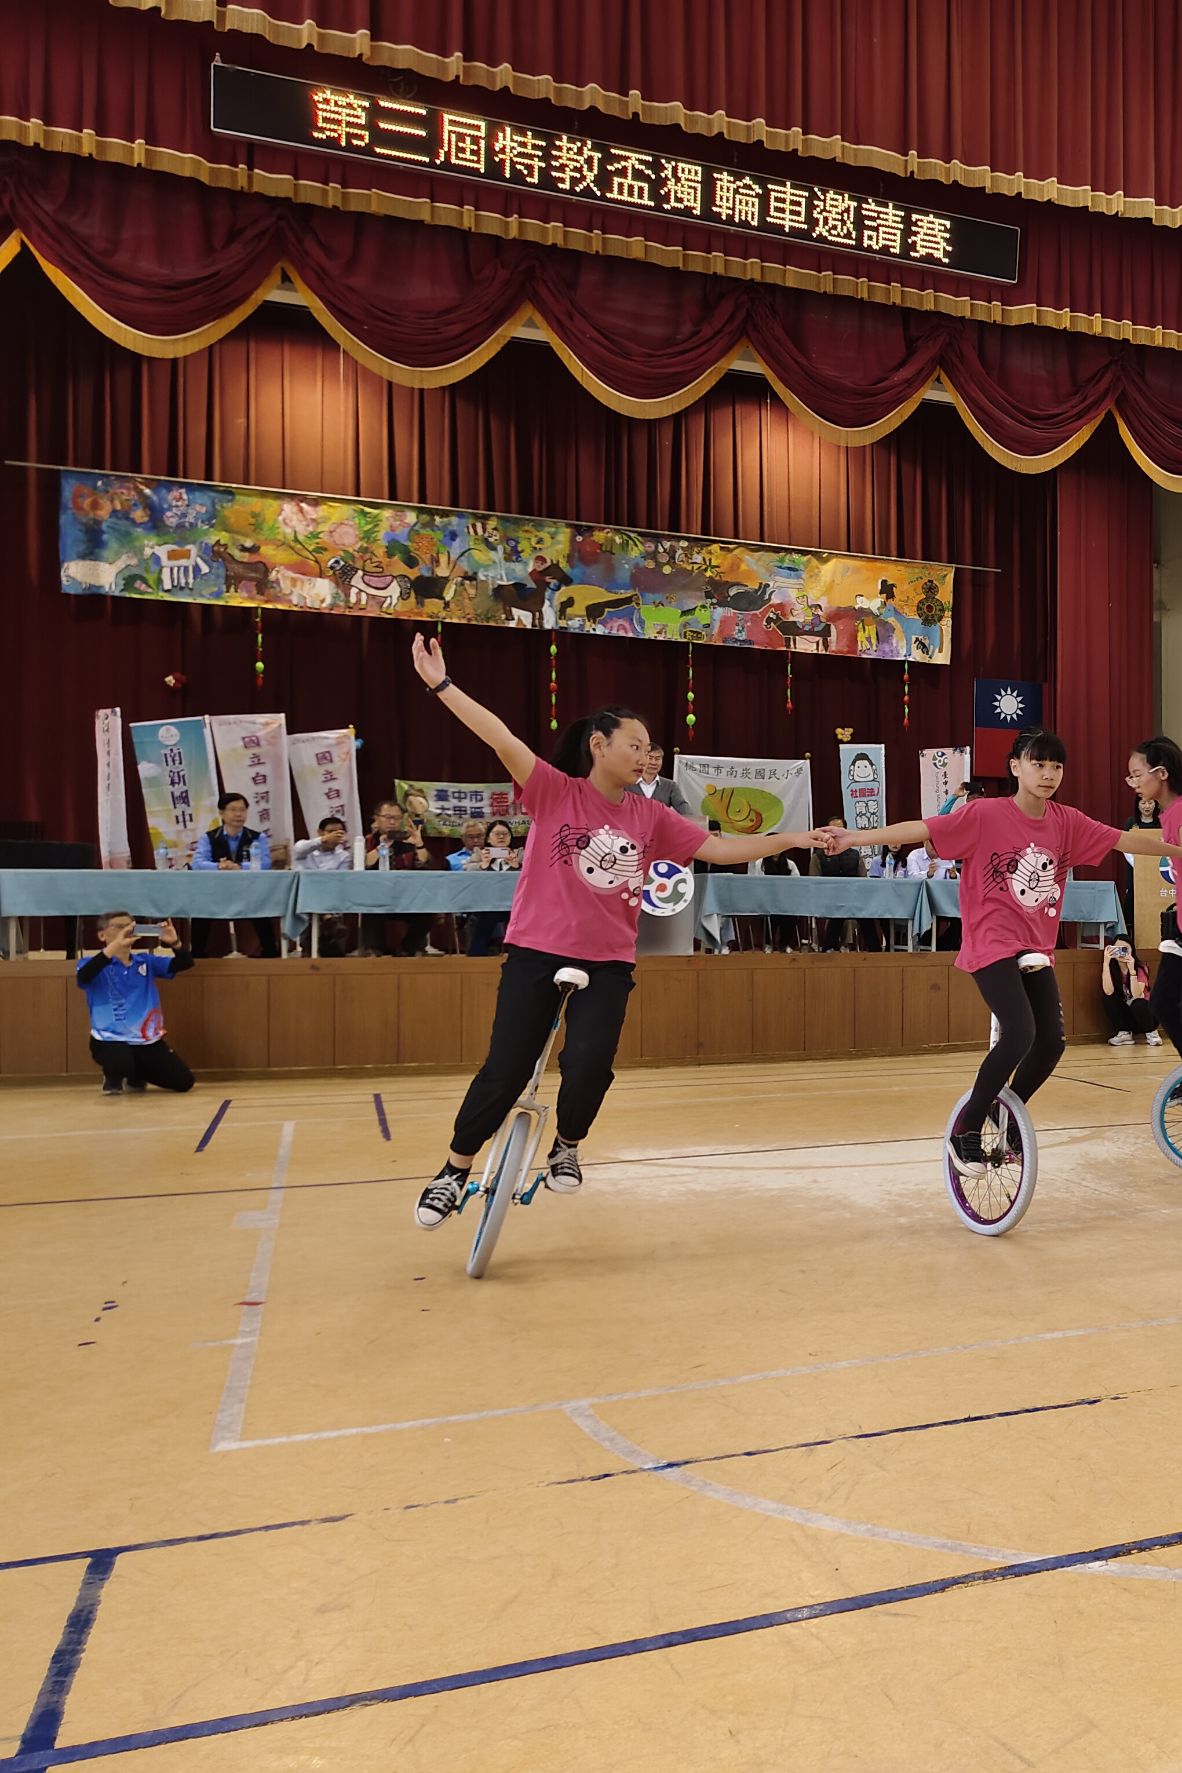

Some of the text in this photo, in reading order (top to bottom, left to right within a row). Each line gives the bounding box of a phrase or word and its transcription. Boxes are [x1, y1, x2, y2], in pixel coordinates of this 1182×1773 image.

[311, 88, 952, 263] 第三屆特教盃獨輪車邀請賽
[164, 748, 194, 829] 南新國中
